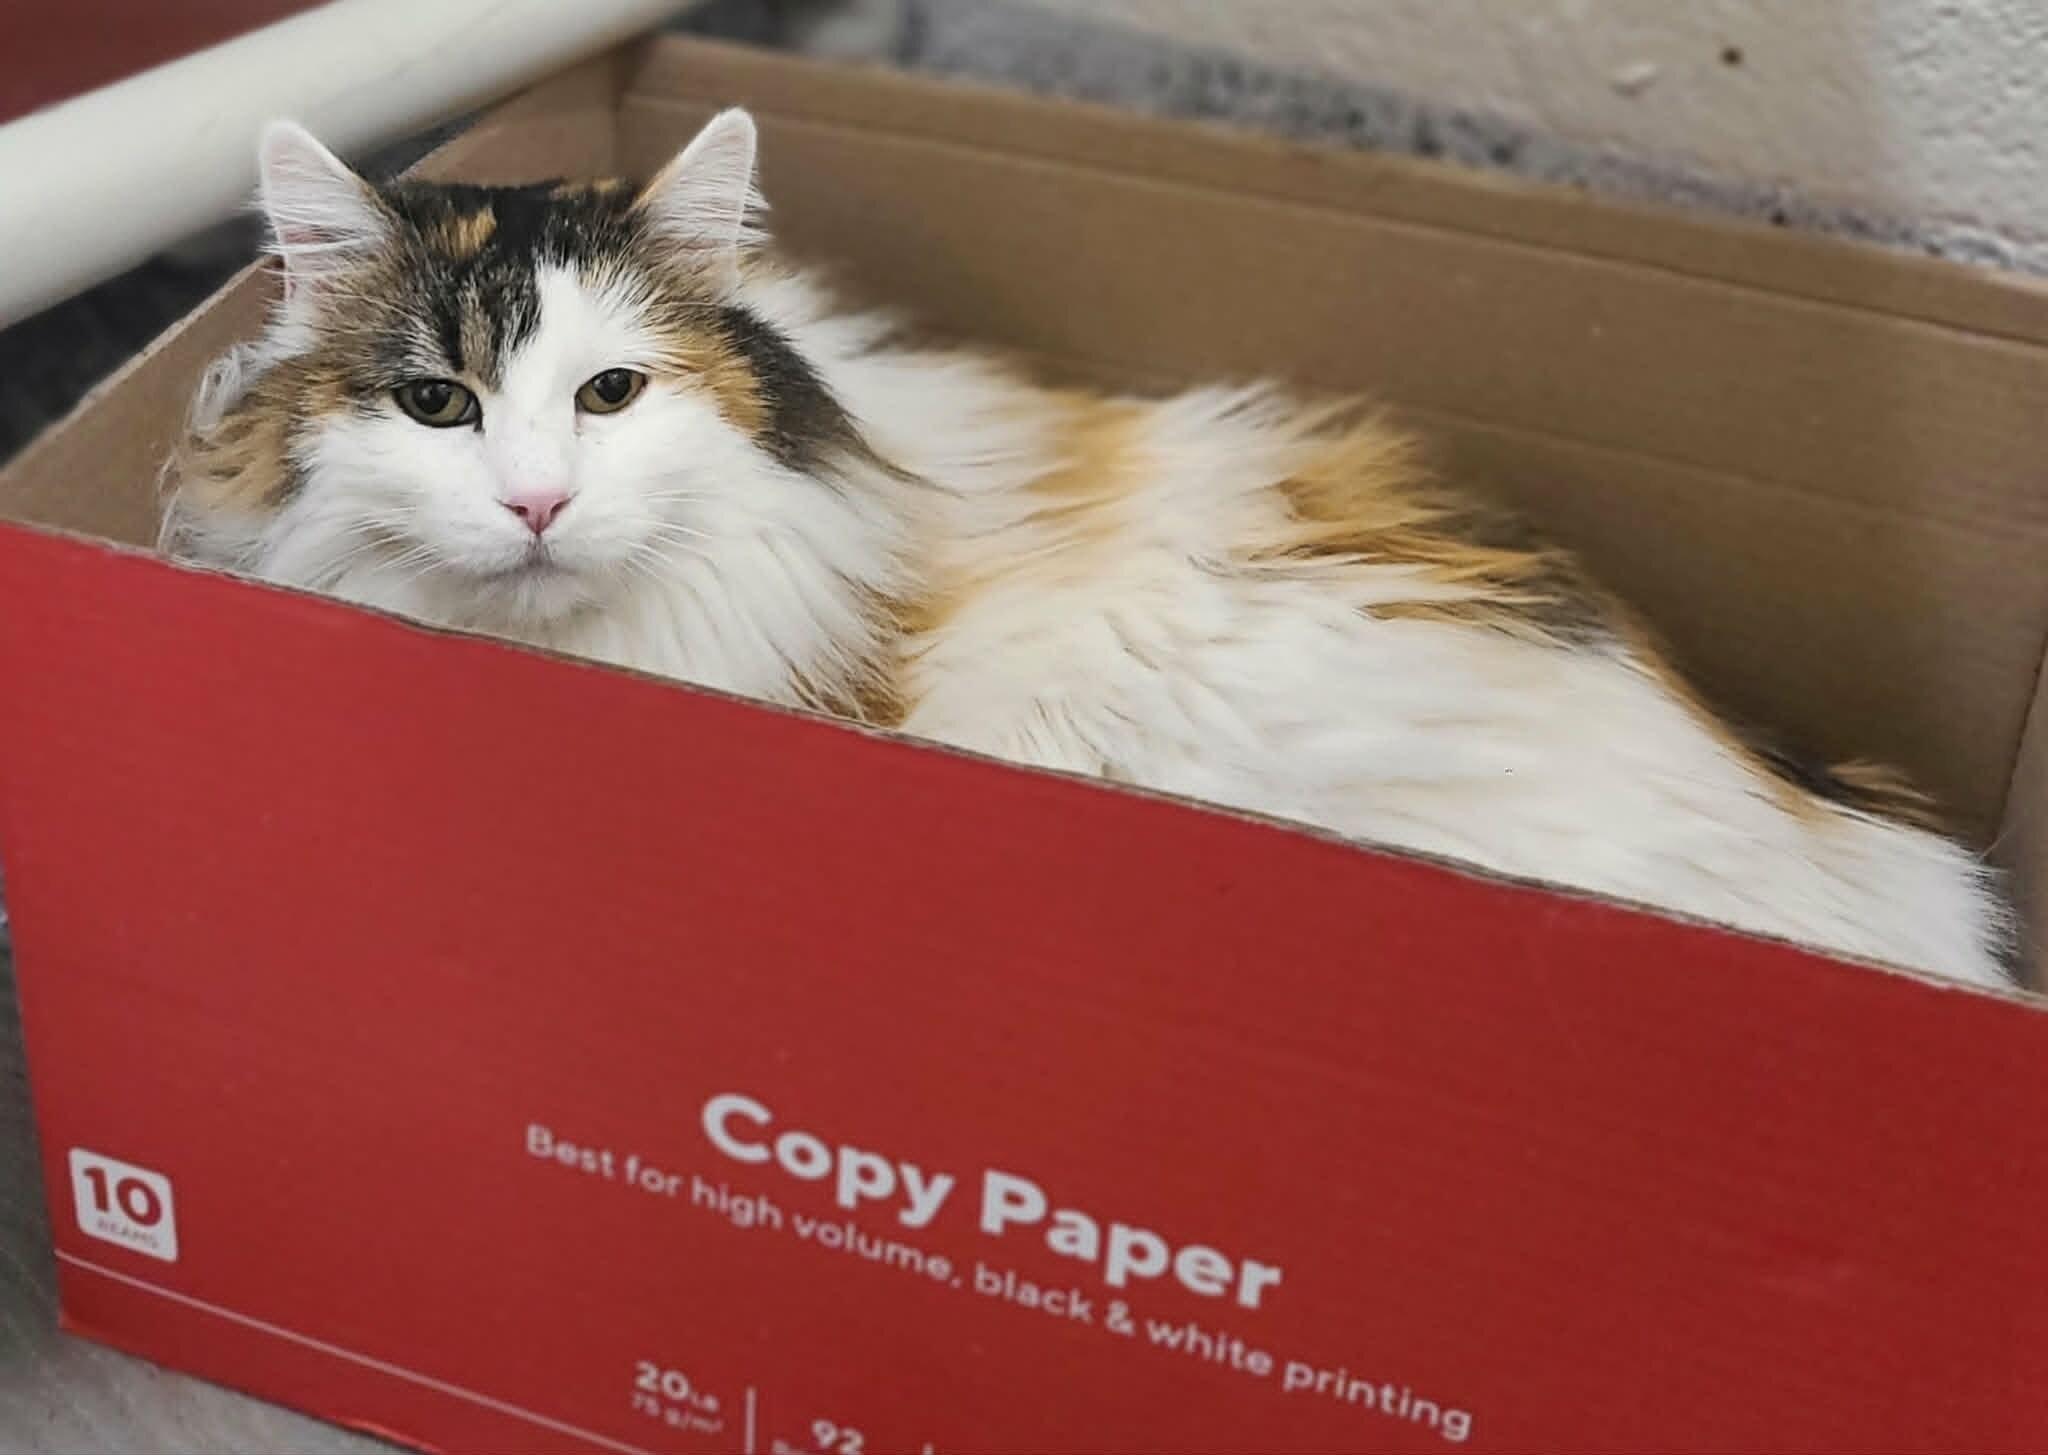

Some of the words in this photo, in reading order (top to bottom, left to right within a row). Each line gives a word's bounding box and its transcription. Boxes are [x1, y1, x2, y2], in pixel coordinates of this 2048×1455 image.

[82, 1166, 162, 1227] 10
[701, 1093, 954, 1228] Copy
[979, 1169, 1281, 1309] Paper
[527, 1124, 613, 1177] Best
[625, 1153, 682, 1198] for
[692, 1175, 783, 1229] high
[794, 1215, 962, 1288] volume,
[975, 1262, 1092, 1323] black
[1105, 1301, 1135, 1336] &
[1146, 1321, 1273, 1376] white
[1283, 1362, 1472, 1443] printing
[810, 1418, 865, 1455] 92
